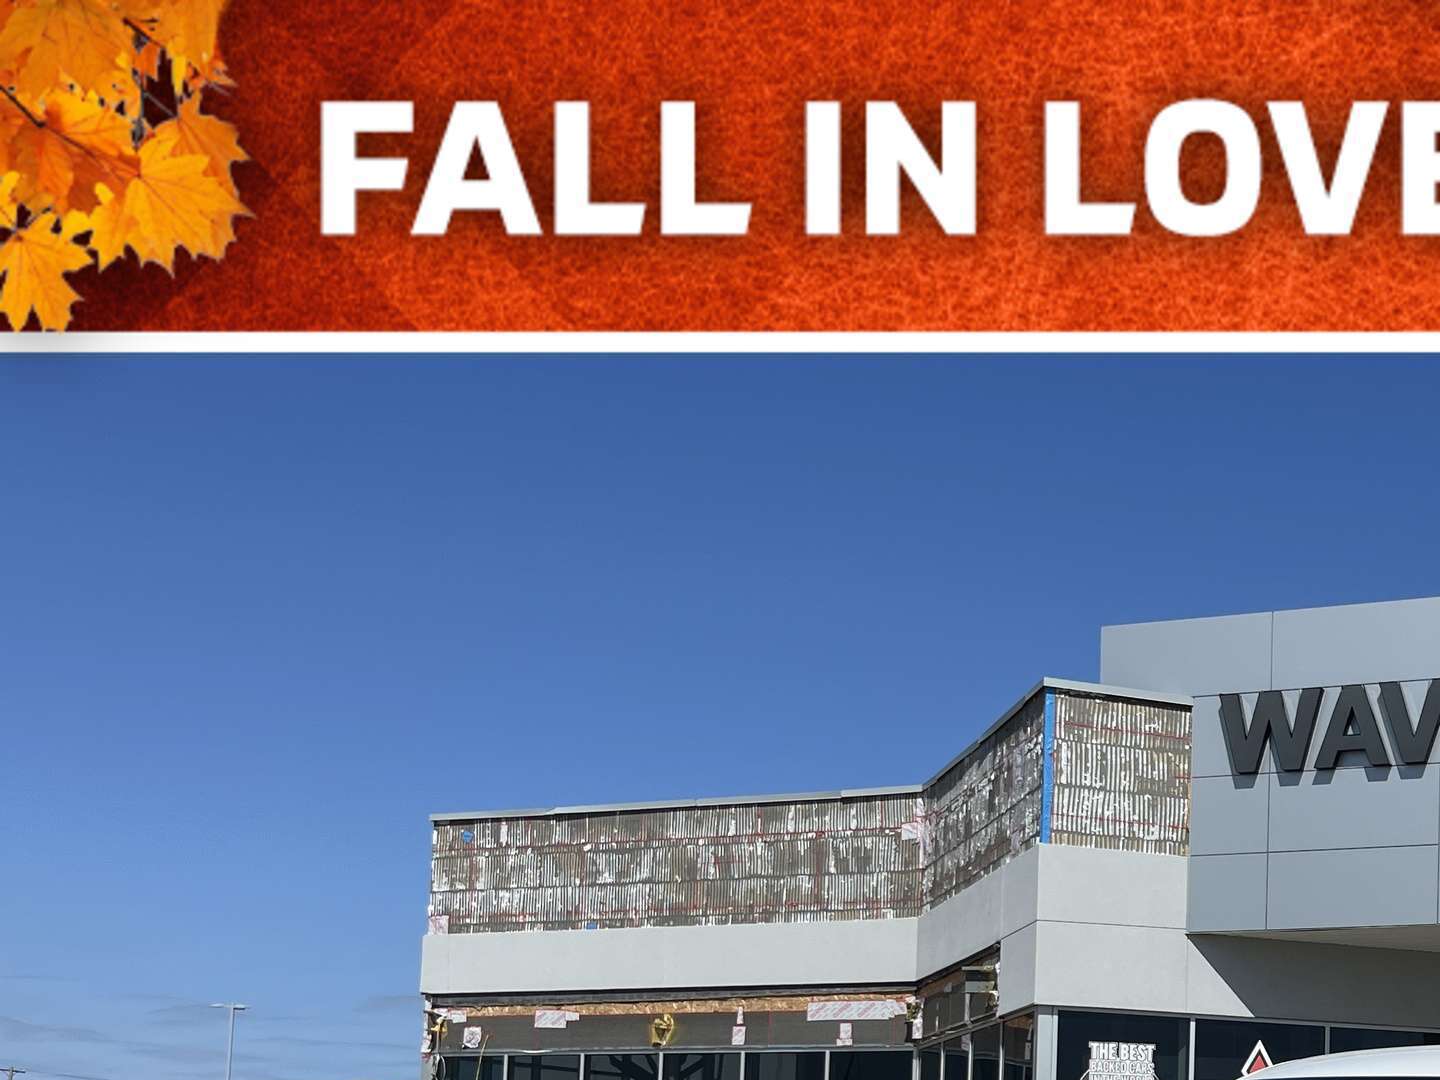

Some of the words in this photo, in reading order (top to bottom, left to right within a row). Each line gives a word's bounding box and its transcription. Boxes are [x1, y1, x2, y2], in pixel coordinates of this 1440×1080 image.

[1089, 1042, 1118, 1060] THE
[1120, 1043, 1155, 1062] BEST
[1090, 1060, 1127, 1073] BACKED
[1129, 1061, 1155, 1074] CARS
